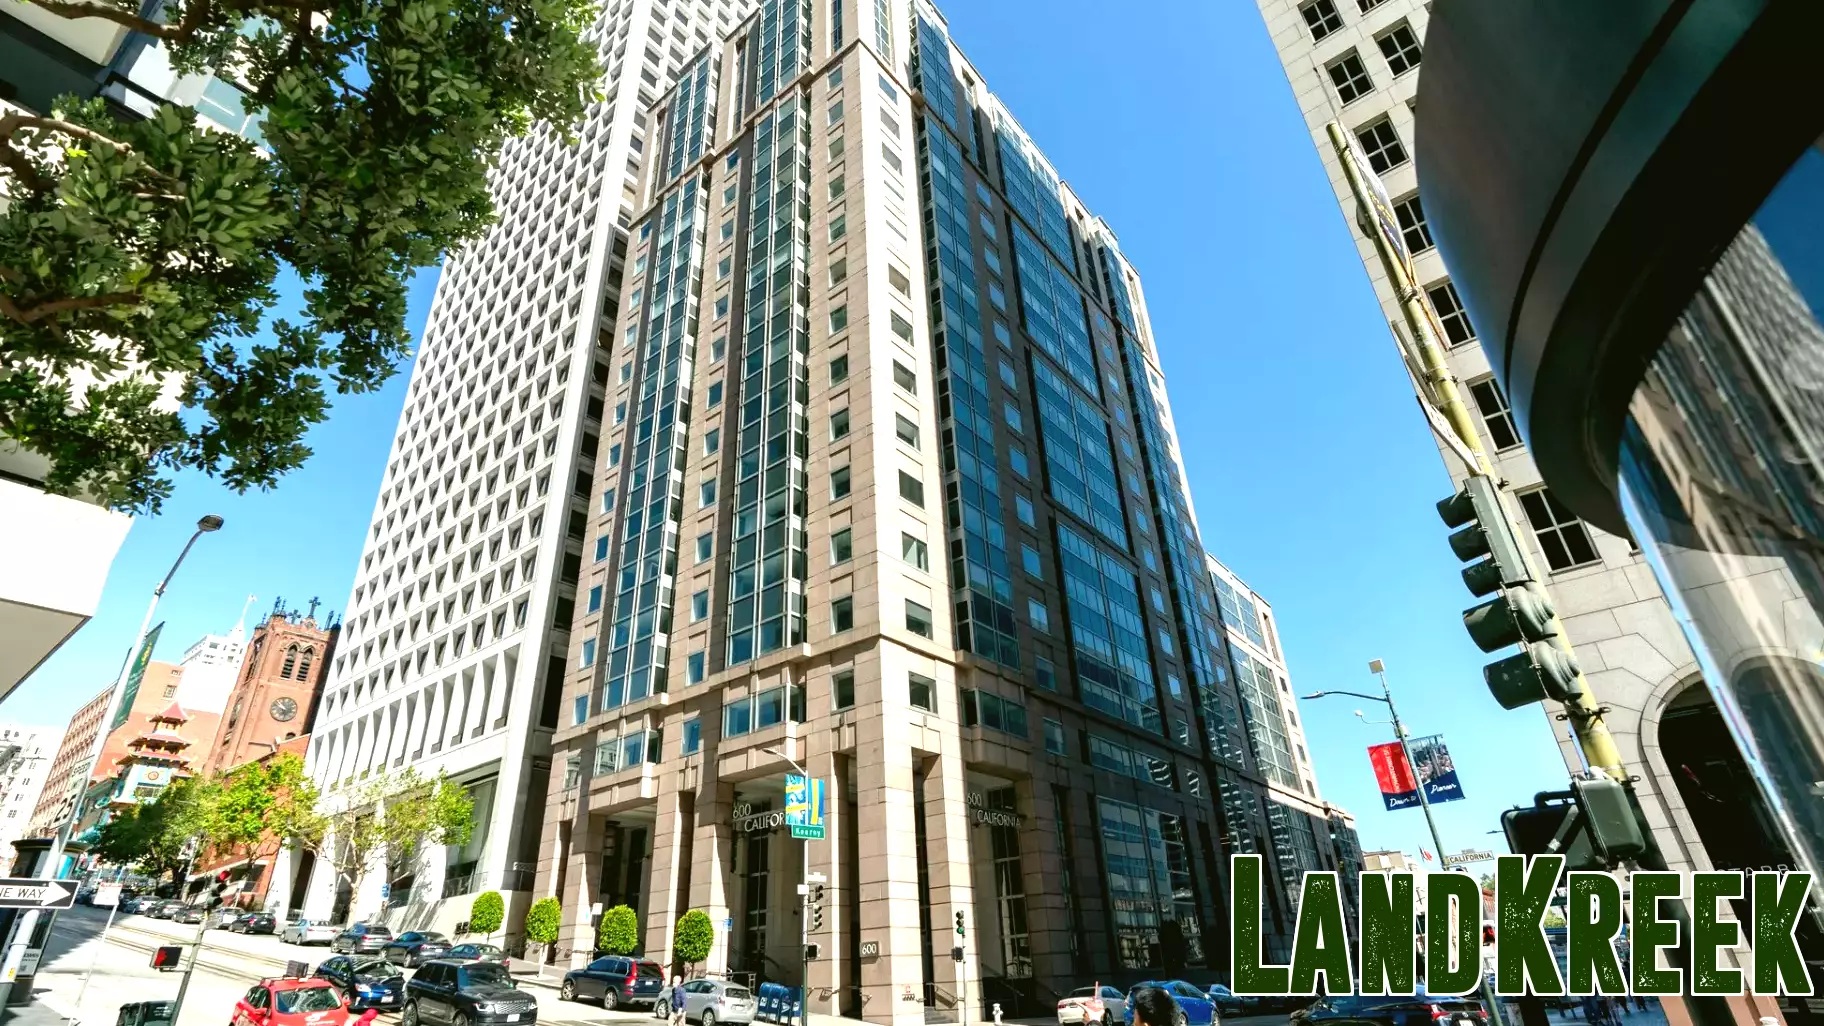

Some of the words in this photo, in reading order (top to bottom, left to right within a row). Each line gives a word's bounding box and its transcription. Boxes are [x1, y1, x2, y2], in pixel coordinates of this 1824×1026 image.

[967, 792, 982, 807] 600
[53, 794, 77, 823] 25
[732, 803, 752, 819] 600
[977, 809, 1021, 828] CALIFORNIA
[795, 827, 821, 838] Kearny
[1449, 852, 1492, 863] CALIFORNIA
[17, 888, 46, 898] WAY
[861, 943, 877, 955] 600
